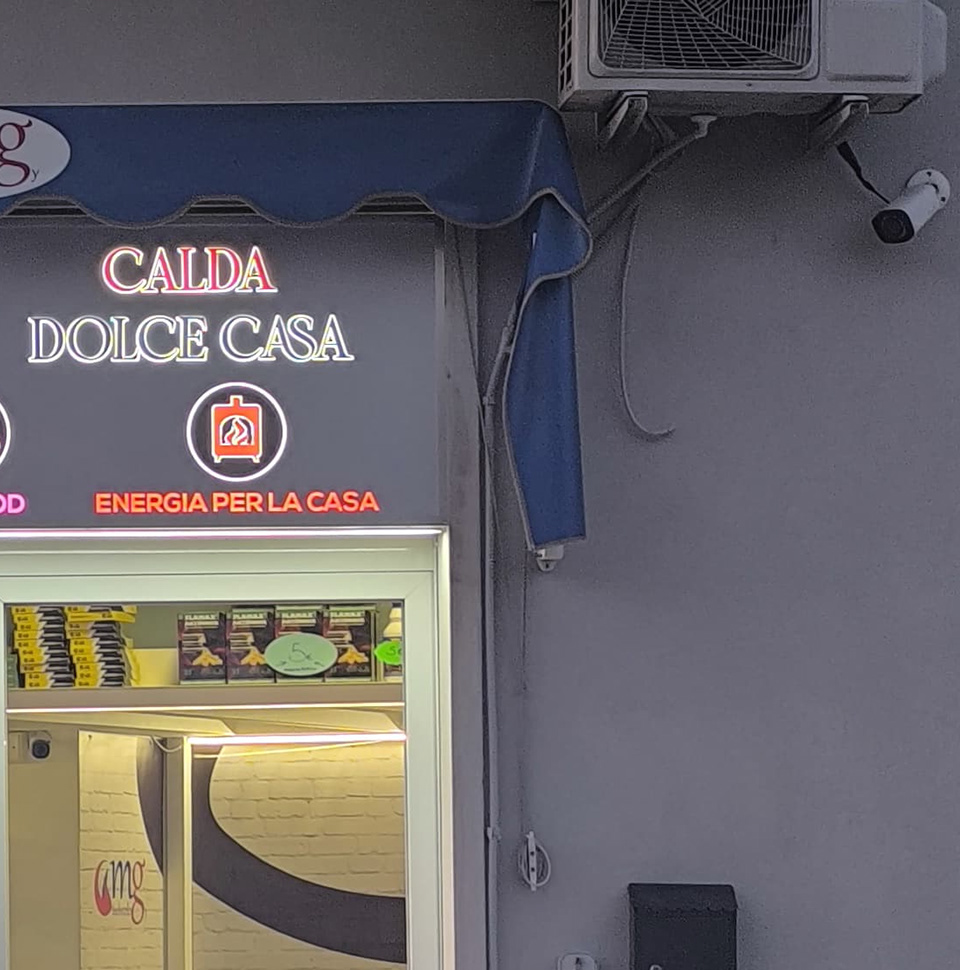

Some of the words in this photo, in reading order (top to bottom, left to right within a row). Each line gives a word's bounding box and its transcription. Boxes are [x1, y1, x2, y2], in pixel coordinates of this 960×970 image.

[102, 246, 278, 295] CALDA
[27, 315, 209, 363] DOLCE
[218, 314, 355, 362] CASA
[94, 492, 208, 514] ENERGIA
[212, 492, 263, 513] PER
[268, 492, 302, 513] LA
[306, 491, 380, 512] CASA
